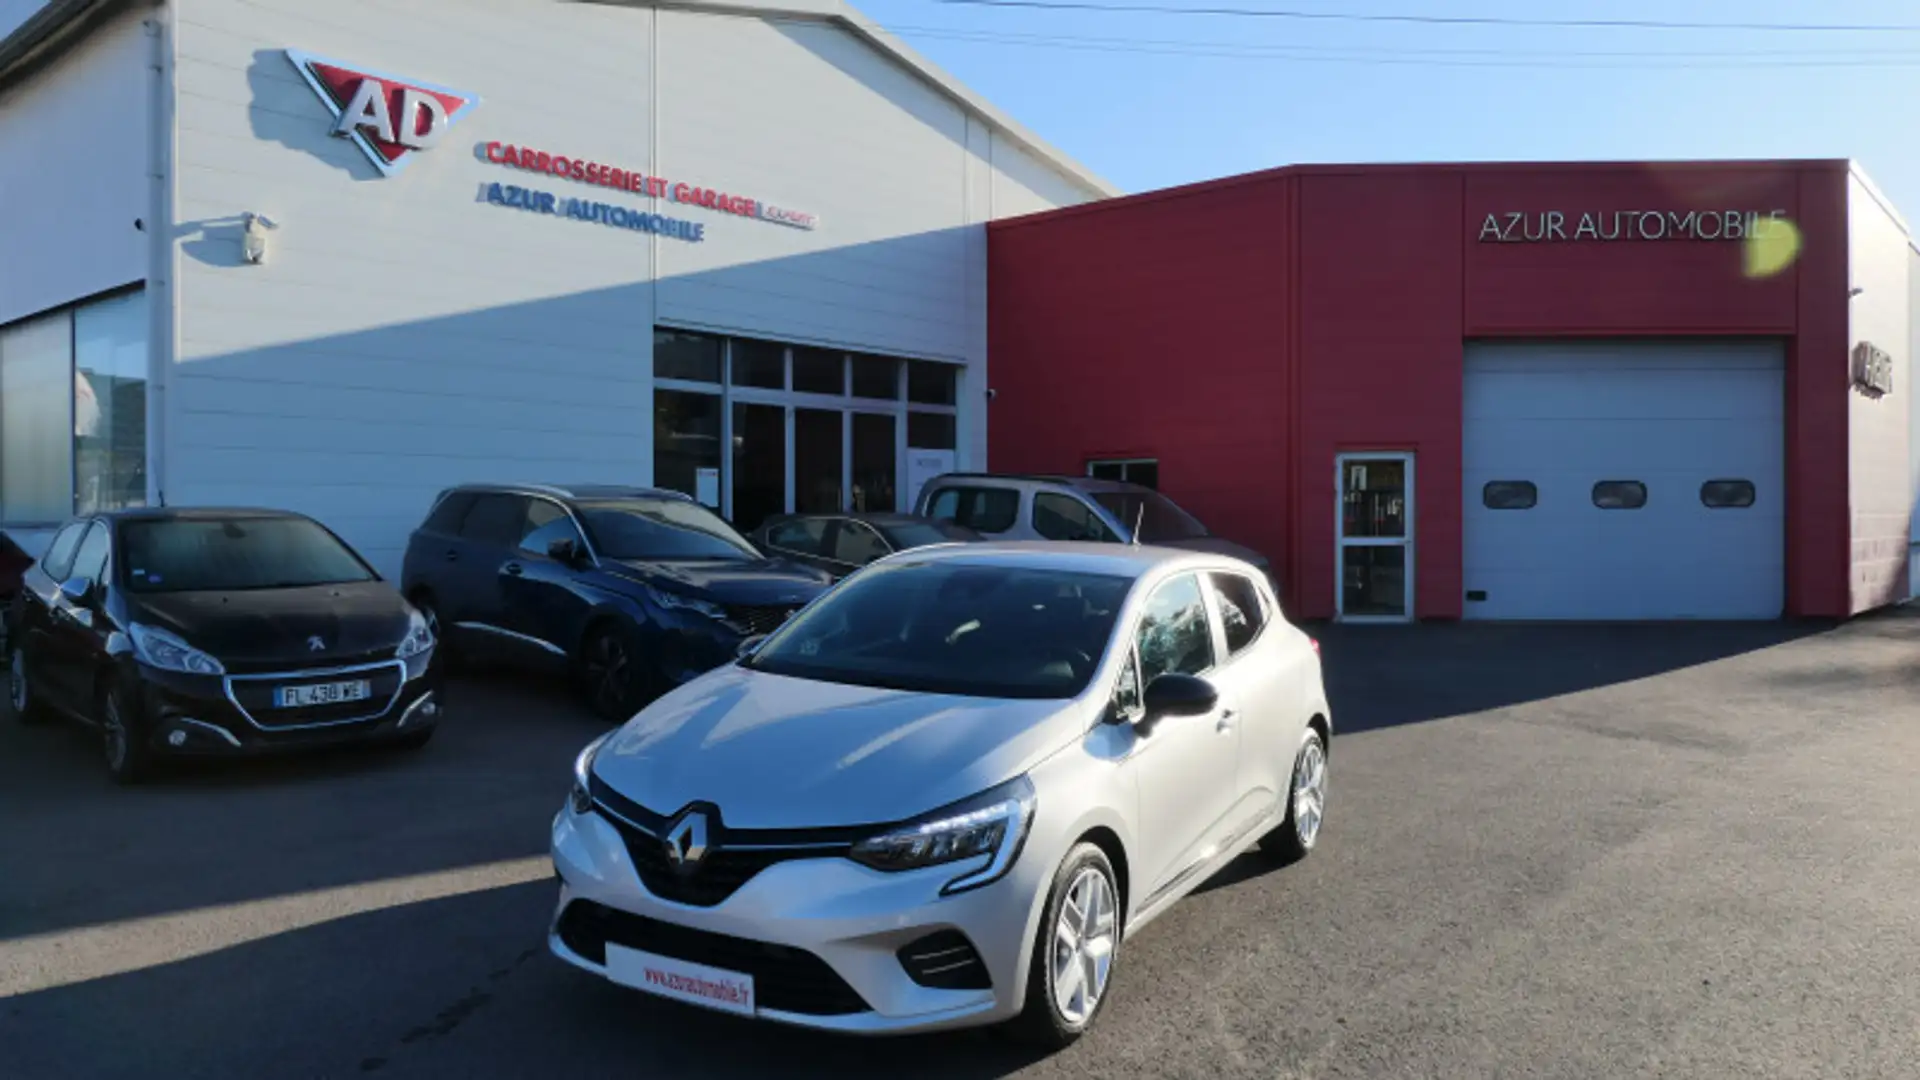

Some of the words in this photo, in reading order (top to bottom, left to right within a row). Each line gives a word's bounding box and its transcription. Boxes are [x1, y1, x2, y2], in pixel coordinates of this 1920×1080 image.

[330, 78, 449, 149] AD
[486, 141, 642, 194] CARROSSERIE
[645, 176, 668, 199] ET
[673, 183, 756, 217] GARAGE
[486, 182, 556, 214] AZUR
[565, 197, 704, 242] AUTOMOBILE
[1478, 212, 1568, 242] AZUR
